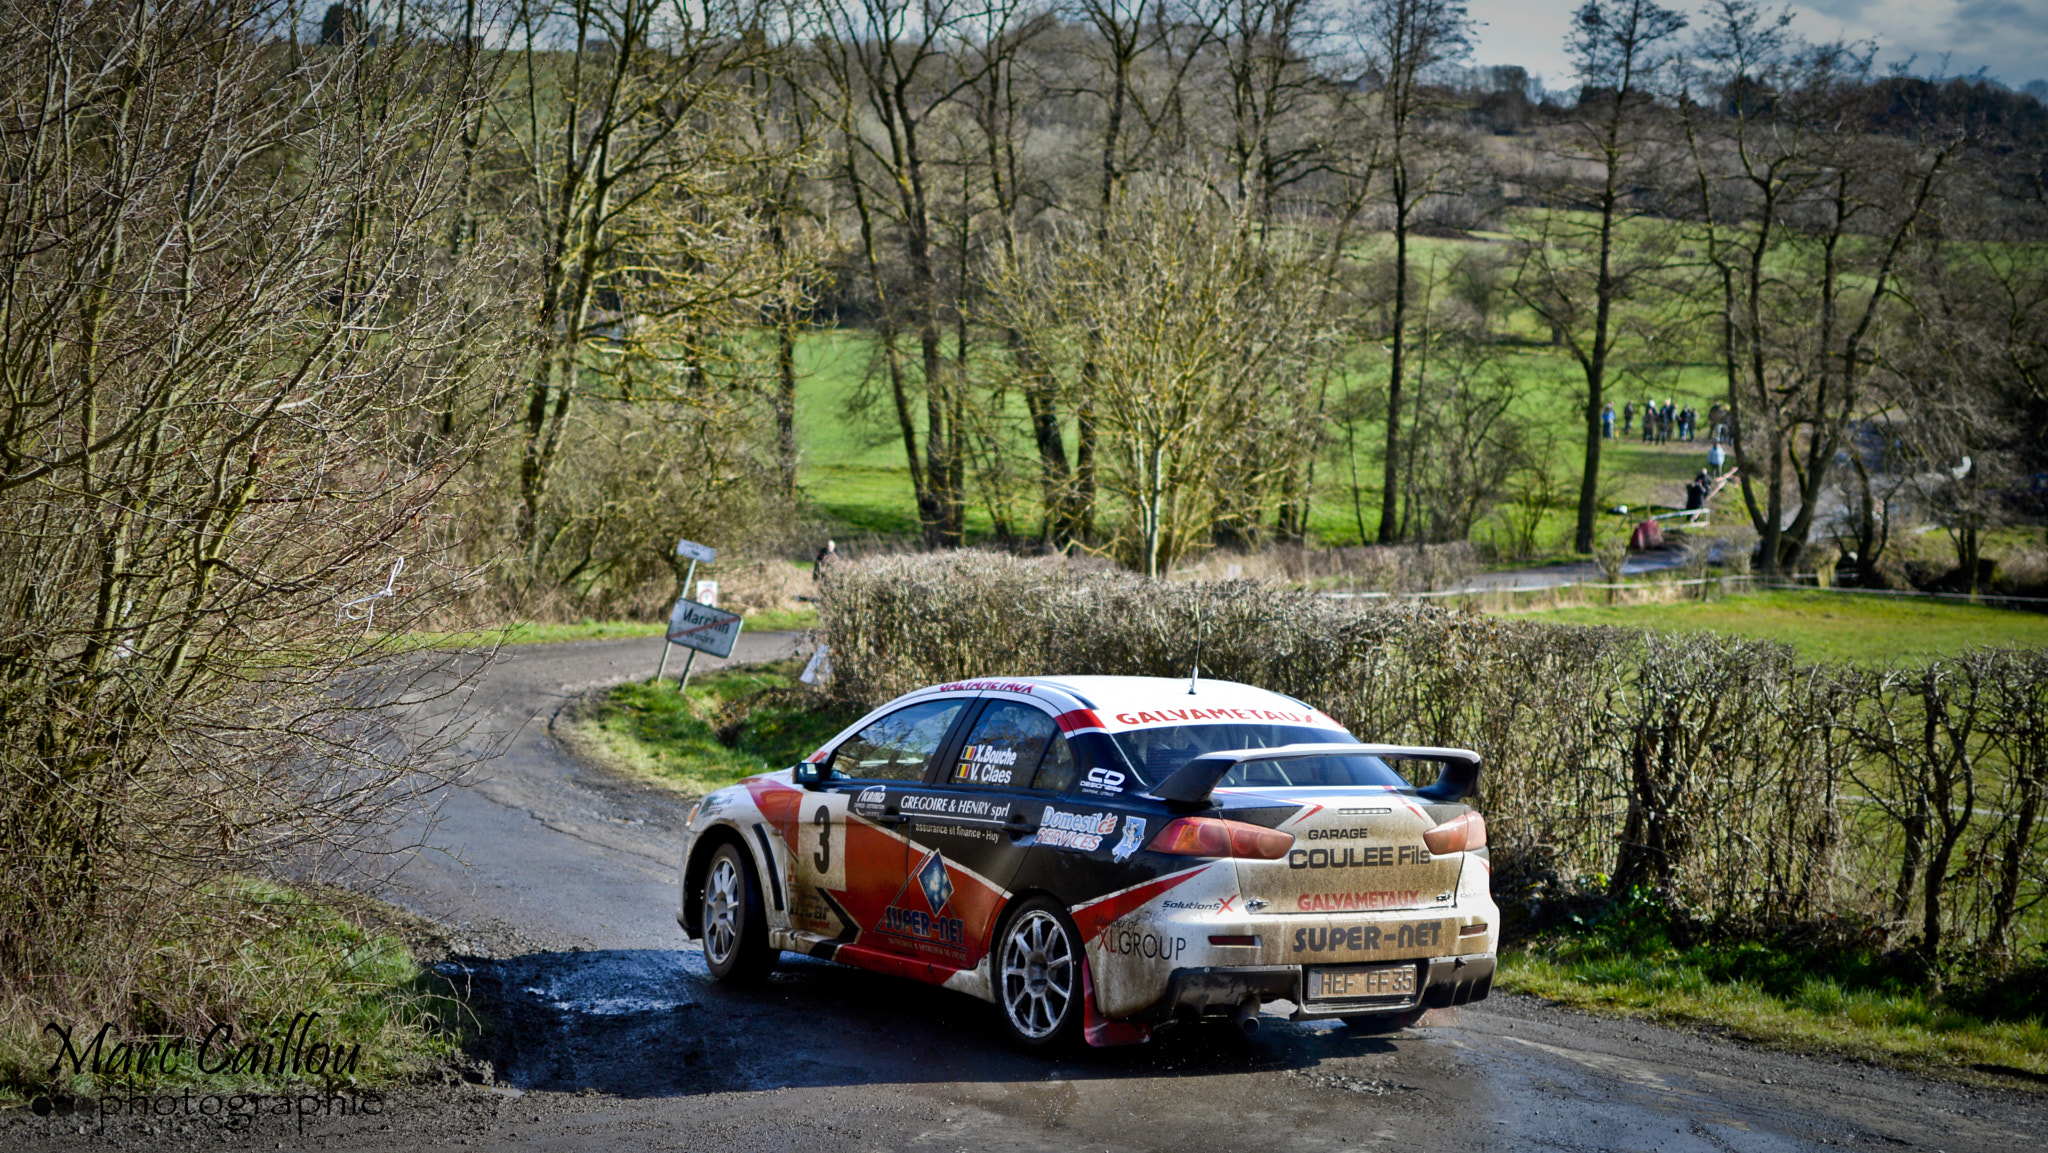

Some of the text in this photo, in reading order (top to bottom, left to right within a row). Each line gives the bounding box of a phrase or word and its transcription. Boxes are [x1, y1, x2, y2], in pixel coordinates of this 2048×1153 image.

[940, 681, 1036, 694] GALVAMETAUX
[1115, 708, 1320, 725] GALVAMETAUX
[973, 744, 1018, 766] X.Bouche
[970, 763, 1013, 784] V. Claes
[1087, 767, 1126, 786] CD
[900, 795, 1011, 821] GREGOIRE & HENRY sprl
[813, 805, 831, 875] 3
[915, 823, 948, 835] assurance
[957, 825, 981, 839] finance
[986, 830, 1000, 844] Huy
[1034, 827, 1103, 852] SERVICES
[1308, 827, 1368, 840] GARAGE
[1288, 845, 1431, 869] COULEE Fils
[1297, 890, 1420, 912] GALVAMETAUX
[1393, 968, 1413, 991] 35
